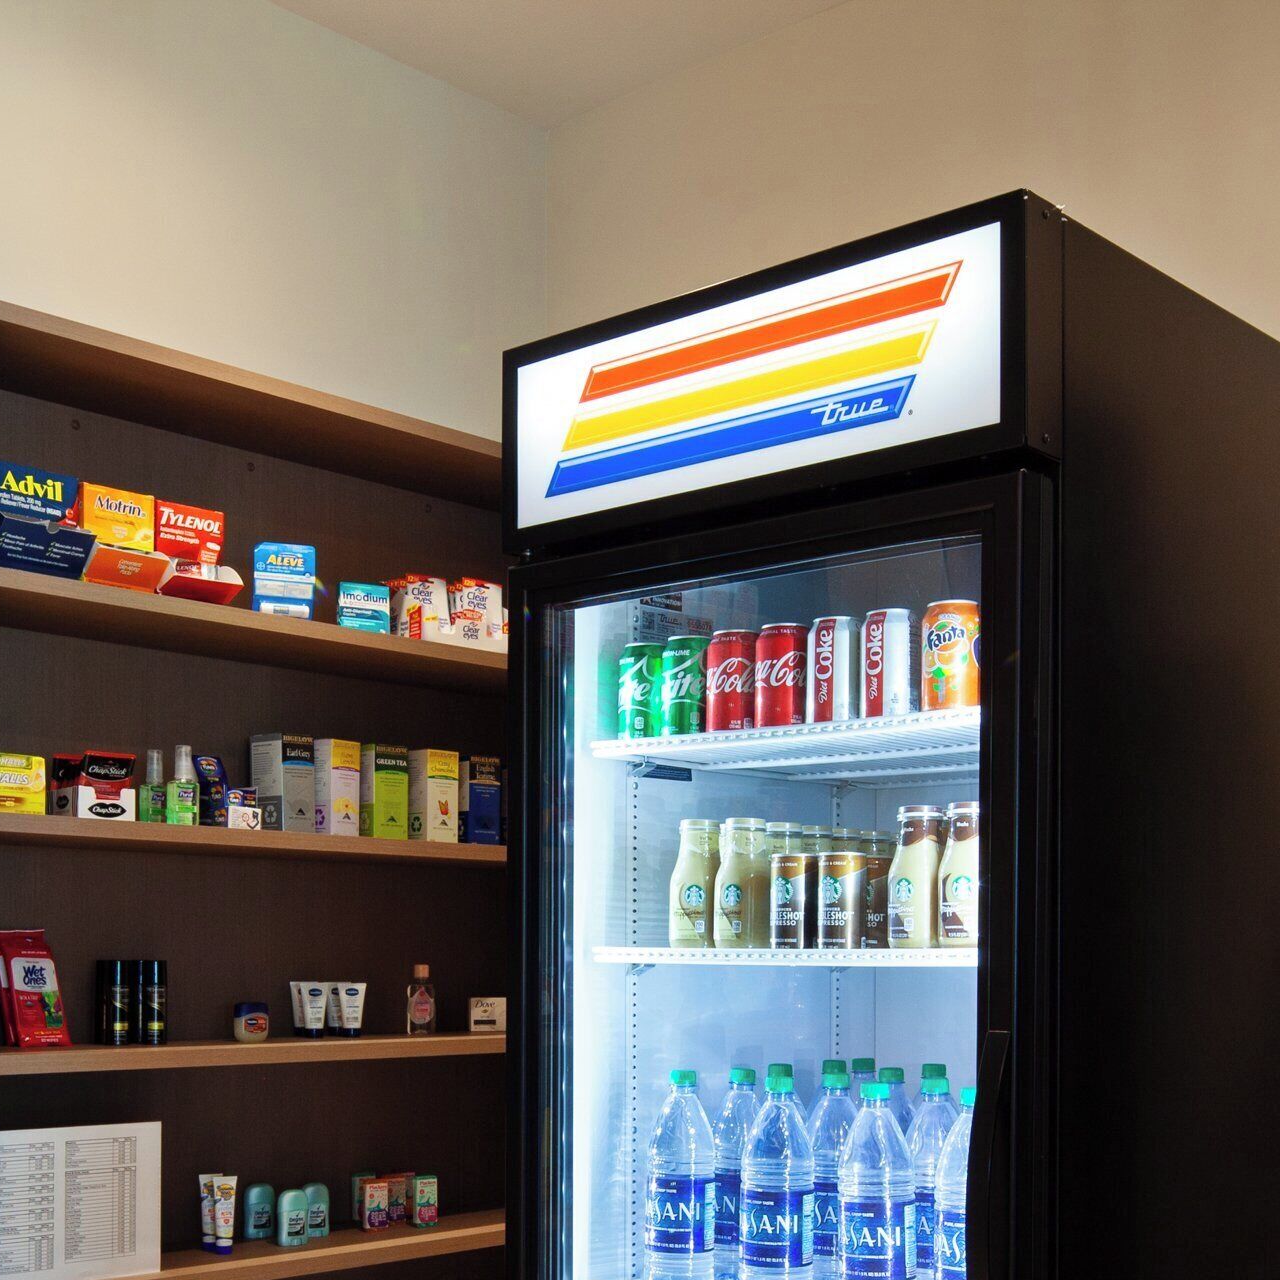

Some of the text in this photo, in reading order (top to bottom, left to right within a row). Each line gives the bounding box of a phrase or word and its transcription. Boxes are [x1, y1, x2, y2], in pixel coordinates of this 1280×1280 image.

[0, 470, 62, 502] Advil
[95, 495, 141, 517] Motrin
[160, 506, 221, 534] TYLENOL
[343, 591, 387, 604] Imodium
[412, 587, 432, 597] Clear
[467, 591, 488, 601] Clear
[414, 596, 432, 605] eyes
[468, 599, 486, 610] eyes
[927, 623, 965, 650] Fanta
[816, 628, 833, 703] Diet Coke
[866, 623, 883, 700] Diet Coke
[283, 735, 313, 743] BIGELOW
[88, 765, 126, 776] ChapStick
[92, 805, 121, 815] ChapStick
[23, 965, 45, 978] Wet
[23, 977, 47, 986] Ones
[474, 1000, 495, 1009] Dove
